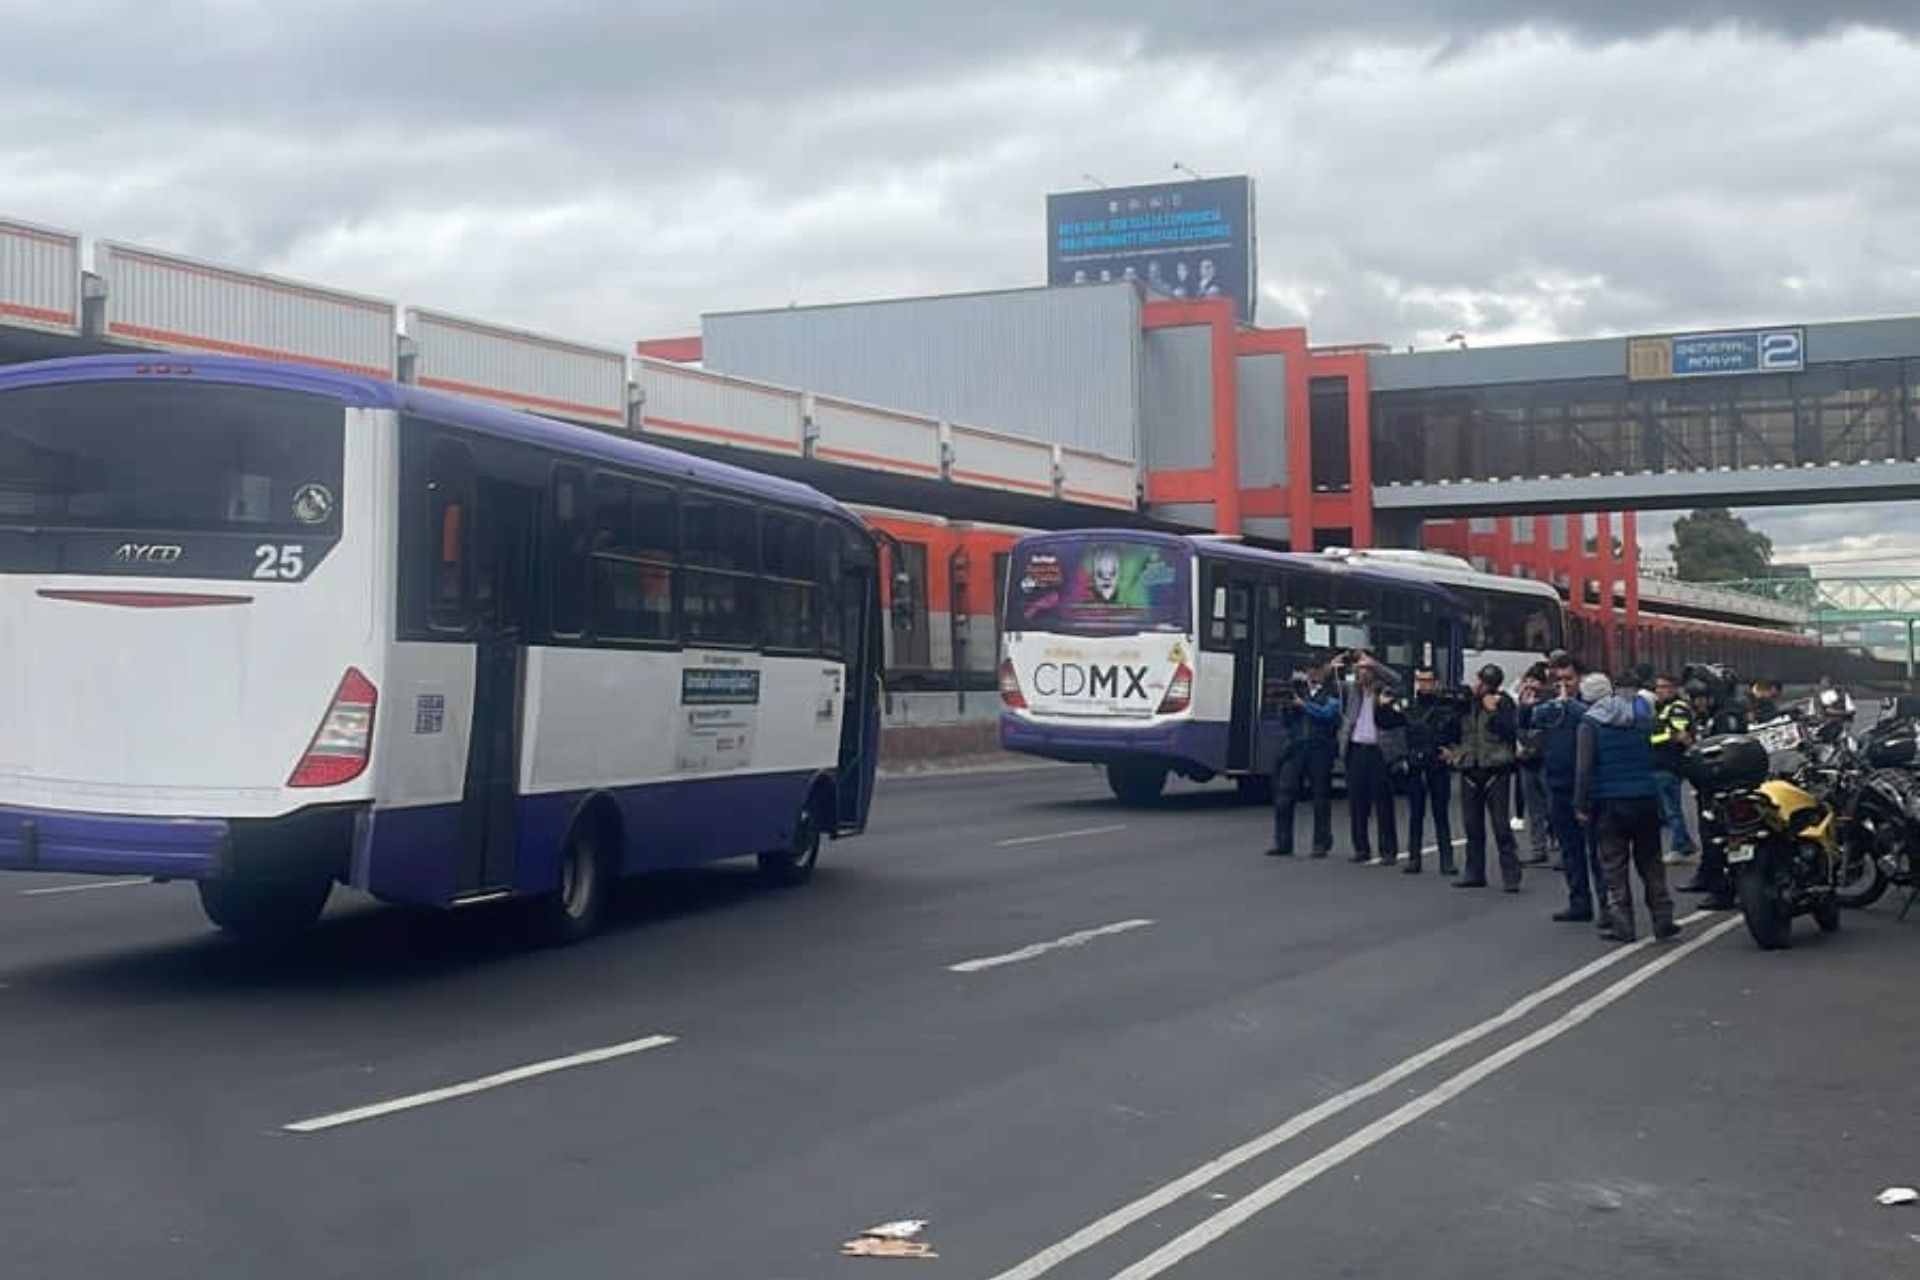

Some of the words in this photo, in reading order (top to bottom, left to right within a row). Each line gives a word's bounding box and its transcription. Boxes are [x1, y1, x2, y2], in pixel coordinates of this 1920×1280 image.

[1763, 334, 1800, 368] 2
[253, 544, 304, 579] 25
[1033, 662, 1149, 699] CDMX
